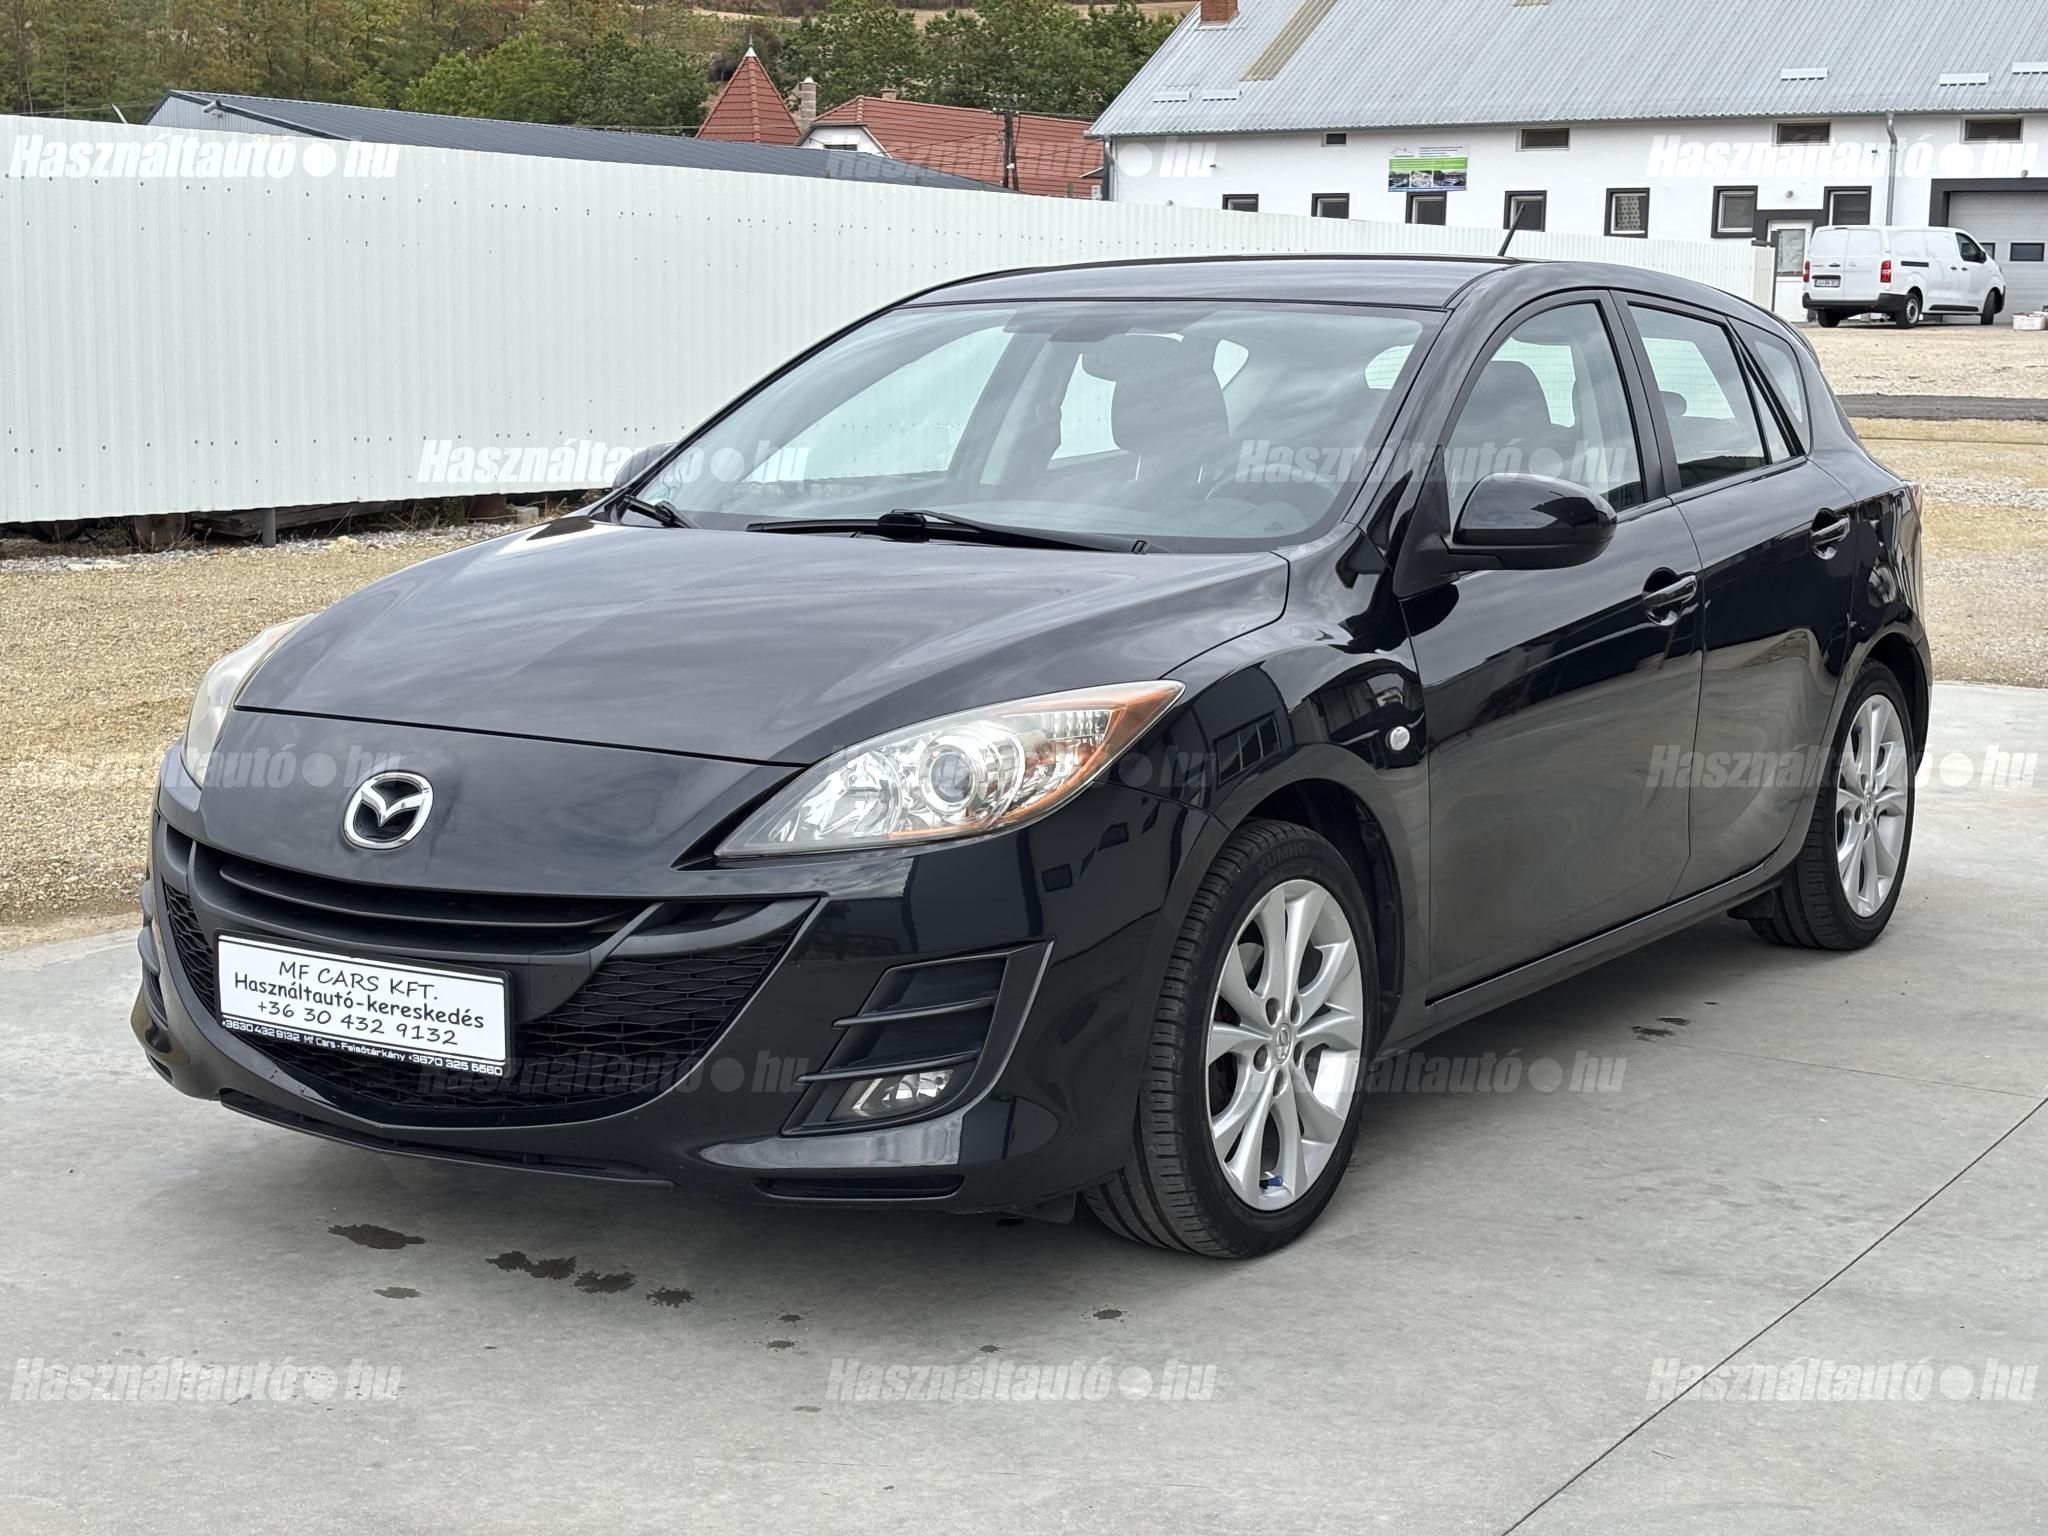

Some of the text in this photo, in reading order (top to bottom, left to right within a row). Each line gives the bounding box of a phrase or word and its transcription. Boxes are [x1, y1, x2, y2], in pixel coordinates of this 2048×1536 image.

[1256, 842, 1309, 877] KUMHO
[234, 972, 485, 1029] Használtautó-kereskedés
[278, 961, 438, 1000] MF CARS KFT.
[258, 1001, 458, 1046] +36 30 432 9132
